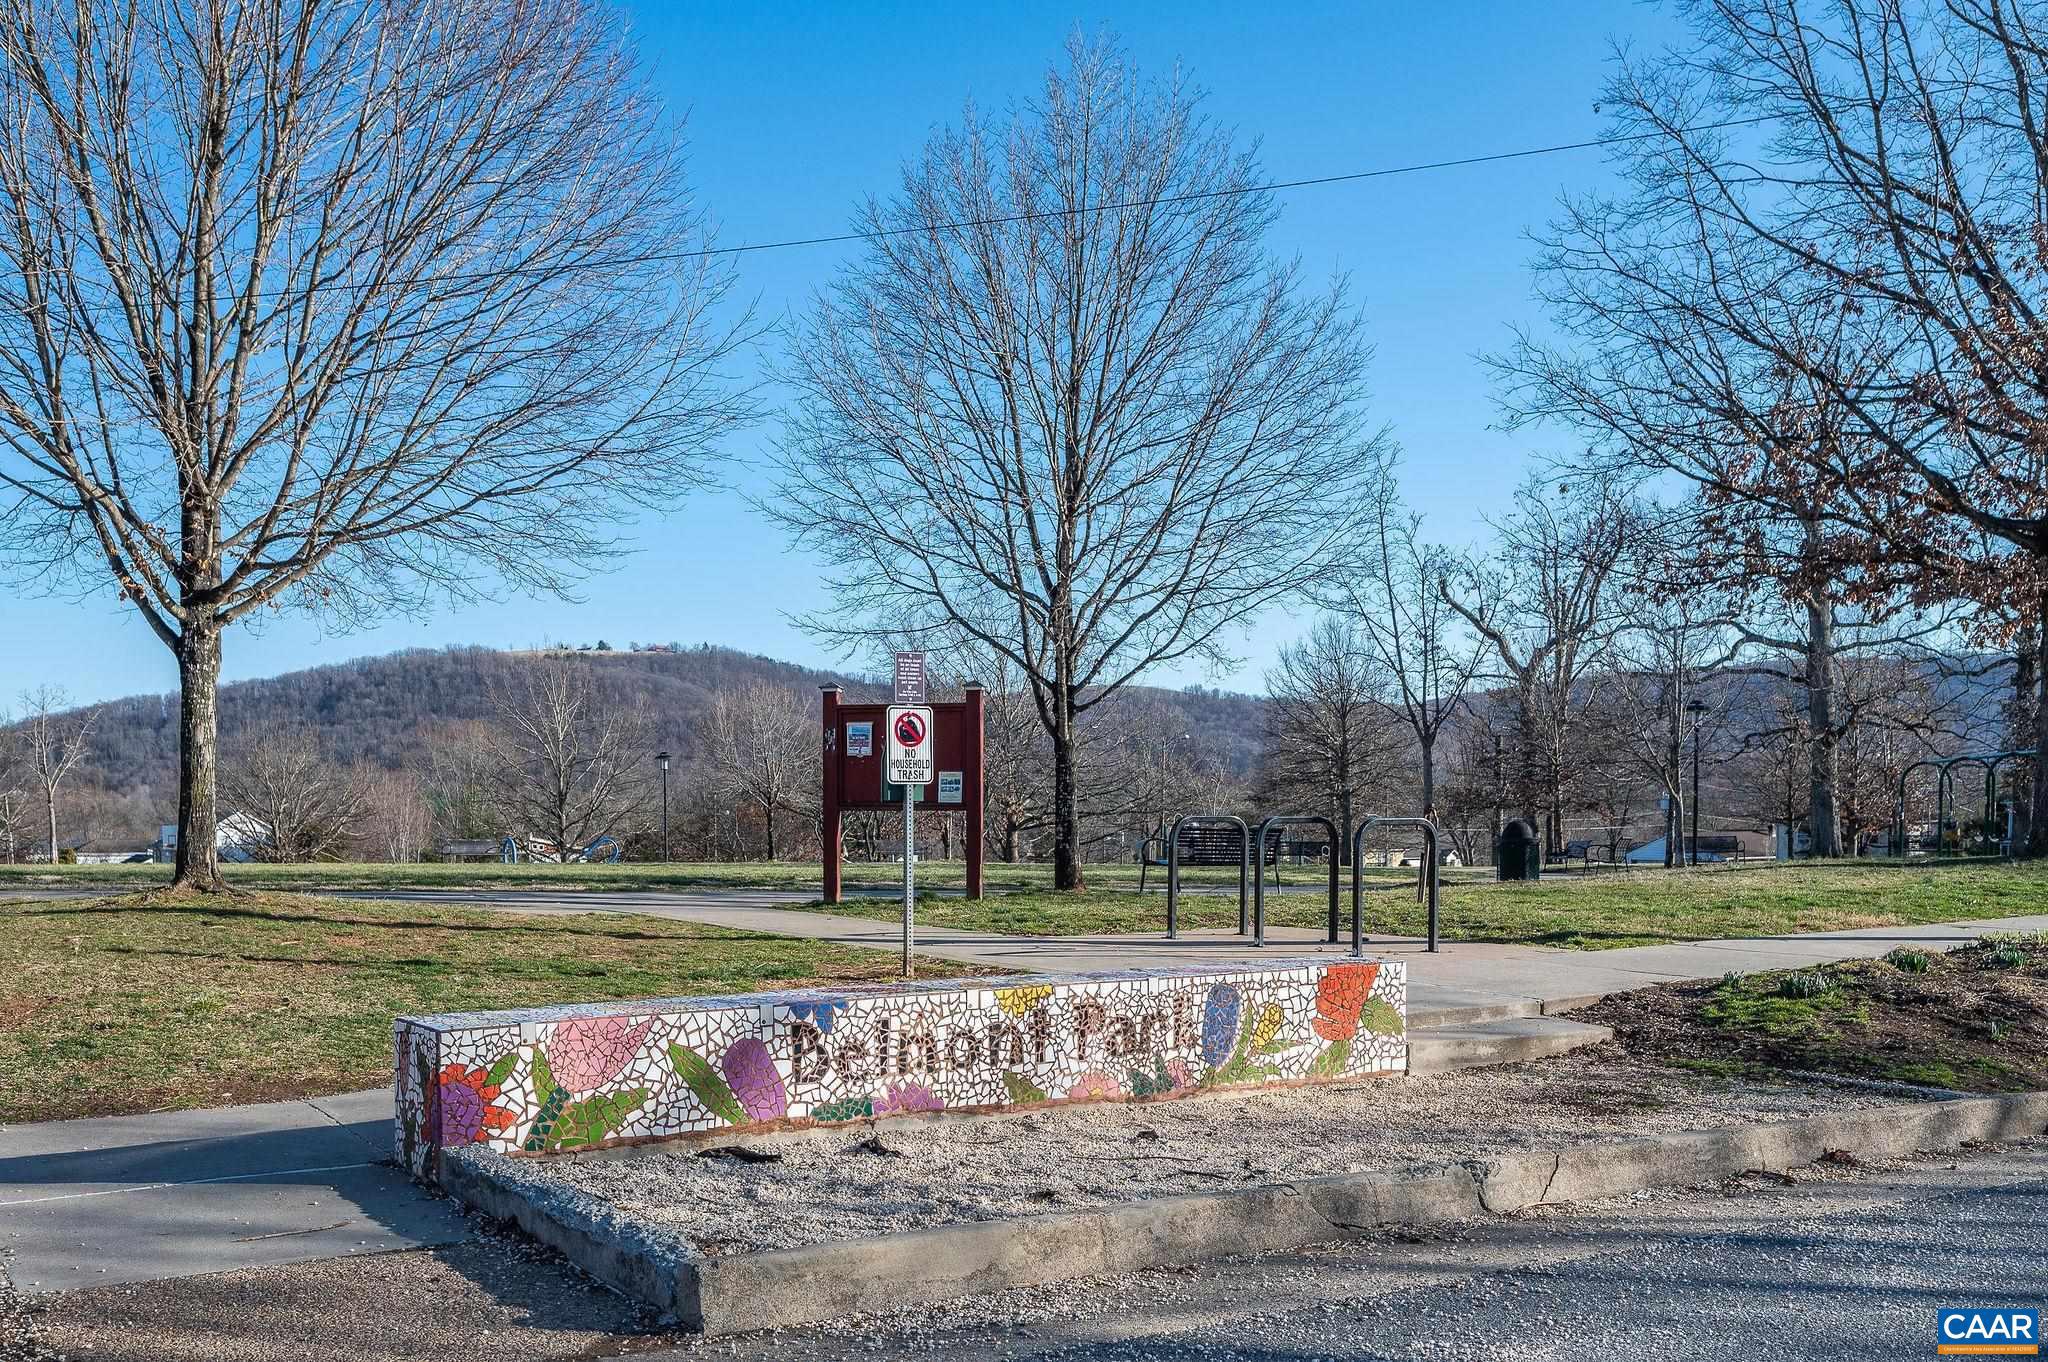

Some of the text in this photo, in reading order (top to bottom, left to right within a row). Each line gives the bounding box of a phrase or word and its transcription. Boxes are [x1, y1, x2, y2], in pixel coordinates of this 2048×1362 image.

[904, 748, 916, 758] NO
[890, 759, 930, 769] HOUSEHOLD
[897, 770, 924, 780] TRASH
[791, 992, 1198, 1085] Belmont Park
